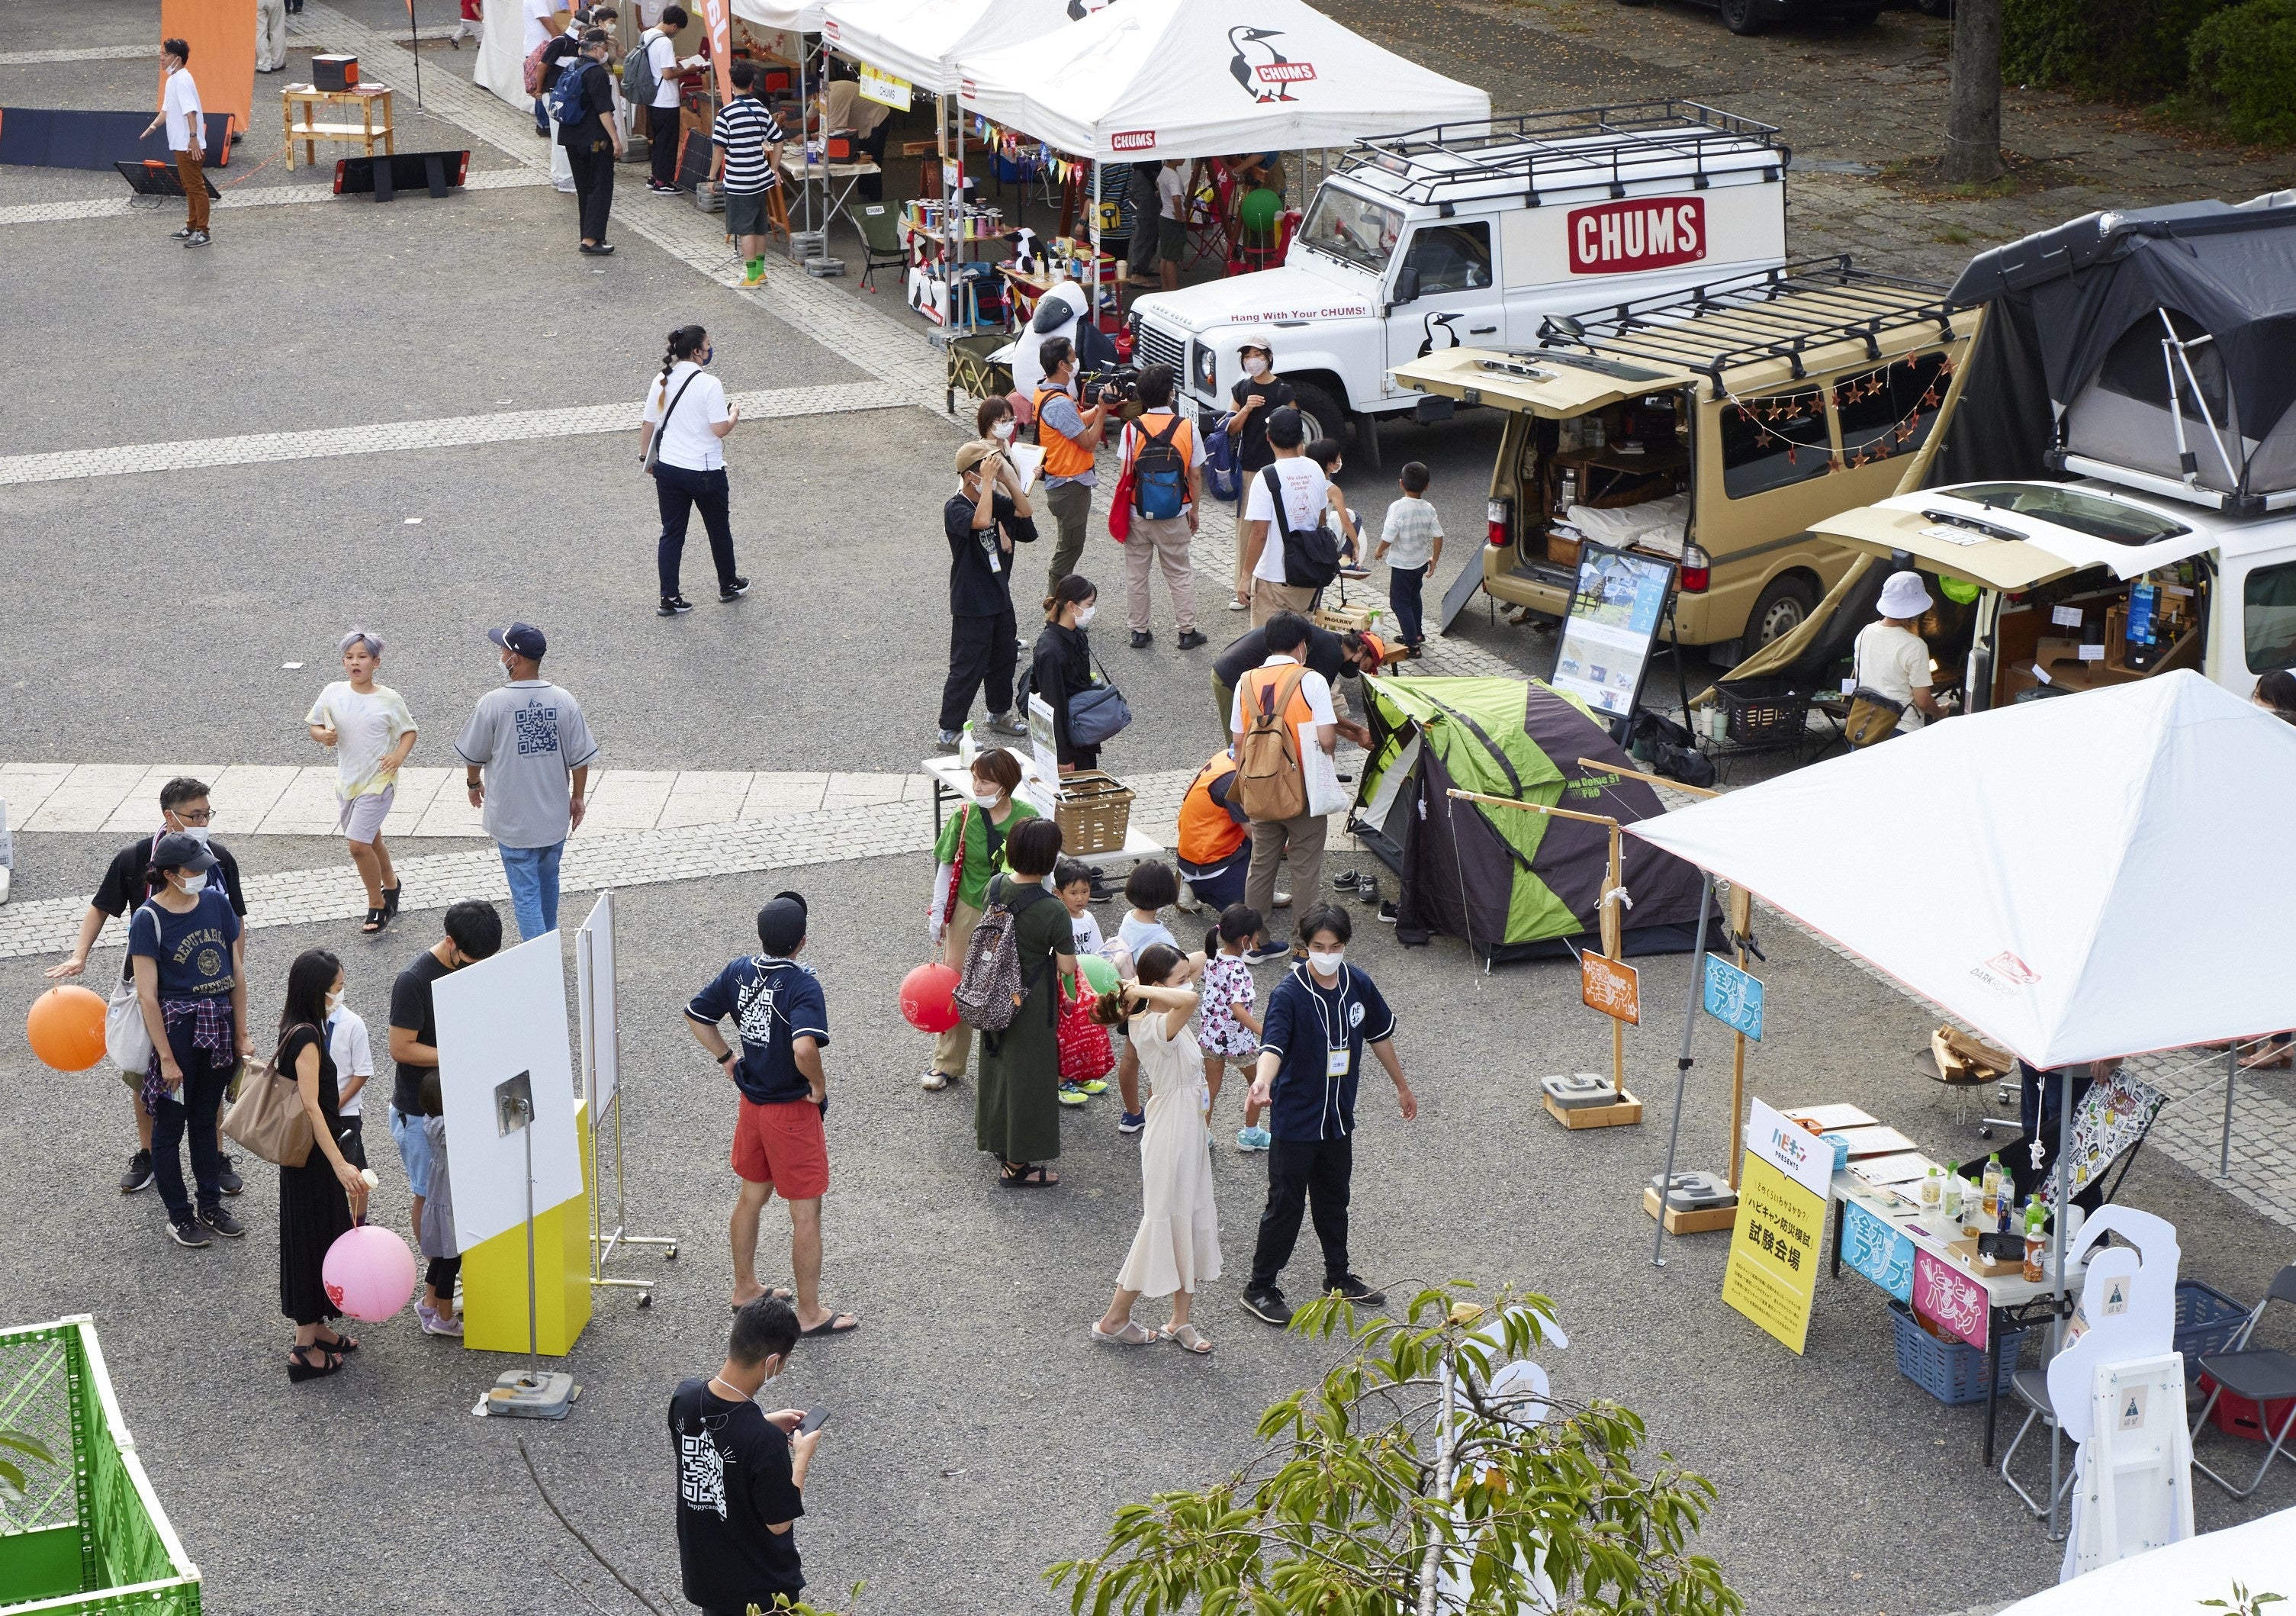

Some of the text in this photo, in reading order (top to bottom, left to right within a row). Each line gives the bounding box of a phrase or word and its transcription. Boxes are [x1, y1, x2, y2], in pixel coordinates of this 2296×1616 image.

[1259, 65, 1313, 81] CHUMS
[879, 85, 896, 99] CHUMS
[1114, 132, 1153, 149] CHUMS
[1577, 204, 1697, 264] CHUMS
[1291, 310, 1317, 318] Your
[1320, 307, 1365, 317] CHUMS!
[1772, 1128, 1807, 1162] ハピキャン
[1775, 1151, 1799, 1171] PRESENTS
[1748, 1218, 1801, 1272] 試験会場
